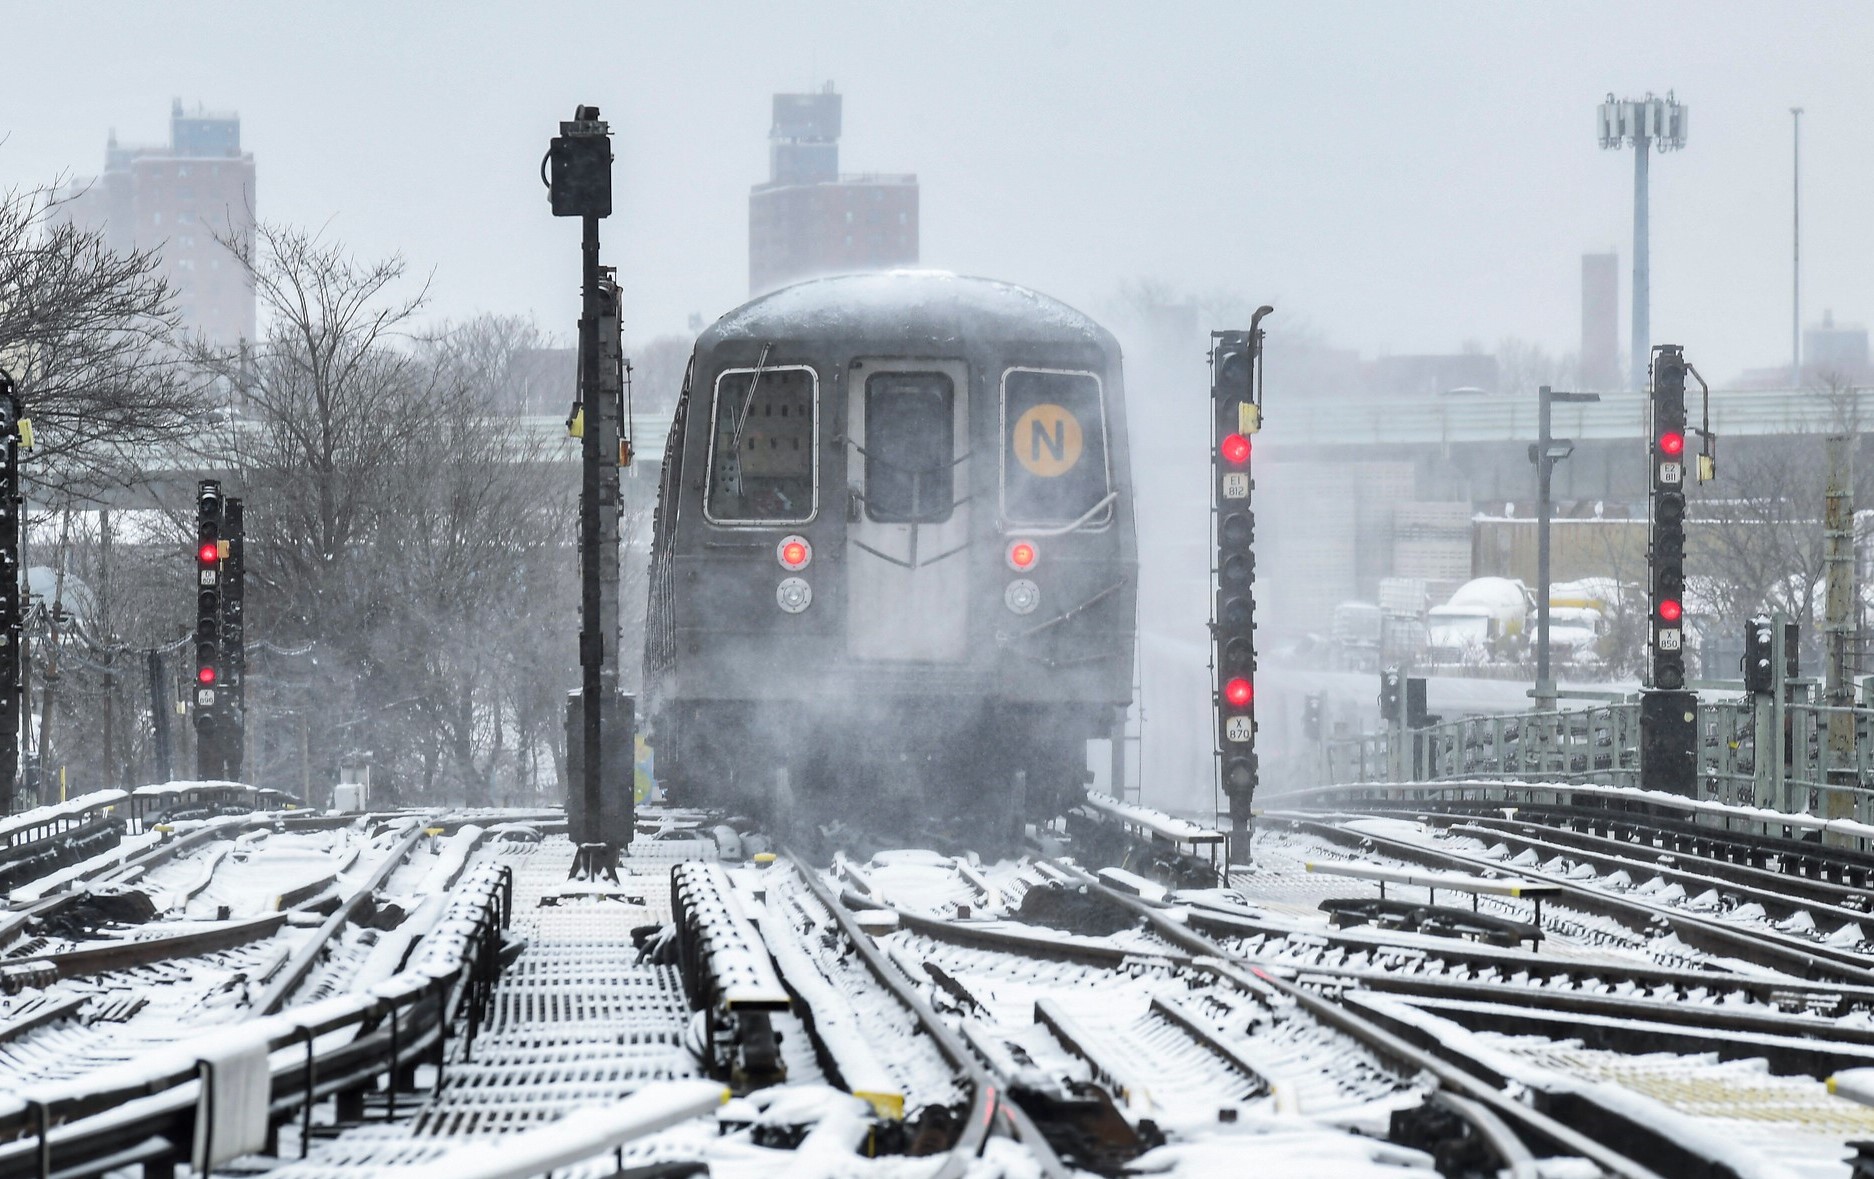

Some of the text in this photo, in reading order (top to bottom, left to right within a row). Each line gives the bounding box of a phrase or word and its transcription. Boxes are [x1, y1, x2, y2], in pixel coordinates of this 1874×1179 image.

[1032, 420, 1064, 461] N
[1665, 464, 1675, 472] E2
[1230, 476, 1240, 485] E1
[1665, 473, 1676, 481] 811
[1229, 487, 1244, 496] 812
[1667, 631, 1672, 639] X
[1661, 640, 1678, 648] 850
[1236, 719, 1242, 728] X
[1229, 729, 1249, 739] 870
